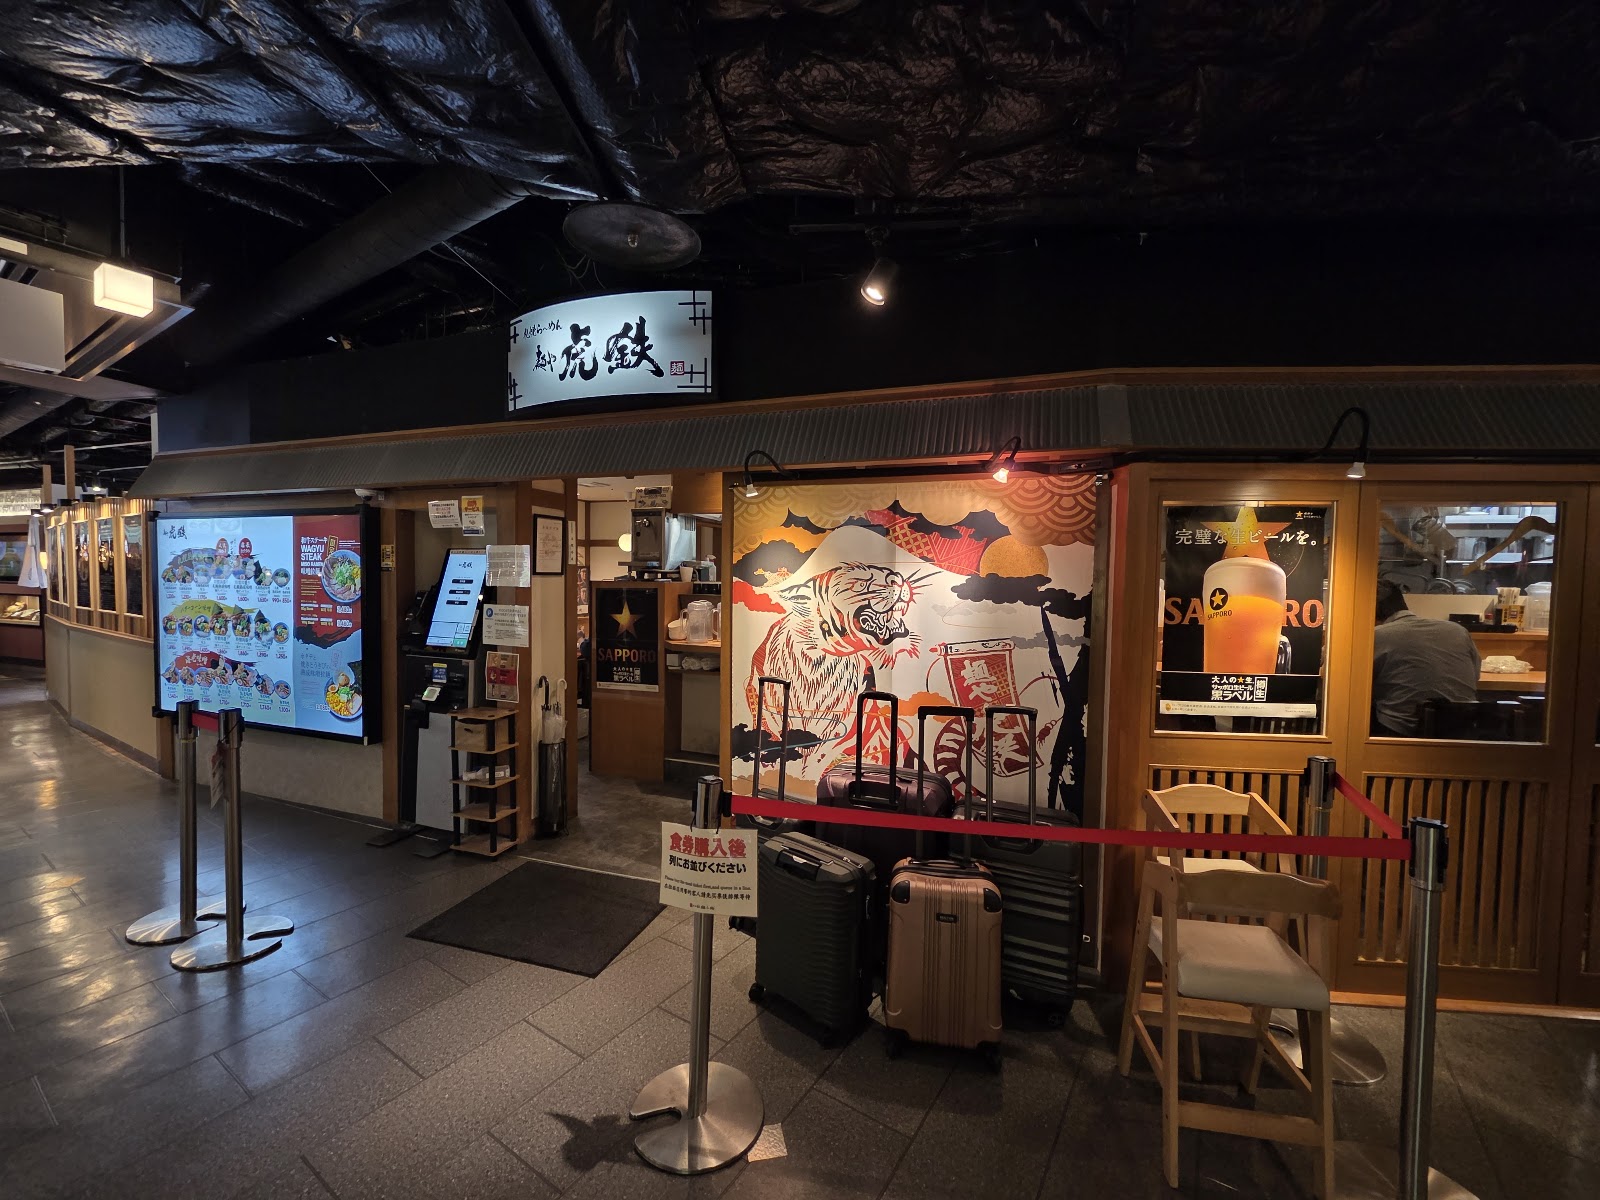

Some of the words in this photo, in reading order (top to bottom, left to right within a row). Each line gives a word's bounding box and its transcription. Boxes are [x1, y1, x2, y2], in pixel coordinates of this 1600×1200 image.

[1175, 528, 1318, 546] 完璧な生ビールを。
[301, 545, 325, 553] WAGYU
[301, 553, 323, 561] STEAK
[1165, 597, 1325, 629] SARO
[1207, 609, 1233, 620] SAPPORO
[598, 648, 656, 663] SAPPORO
[1211, 690, 1254, 701] 黒ラベル
[669, 832, 747, 858] 食券購入後
[668, 854, 747, 873] 列にお並びください
